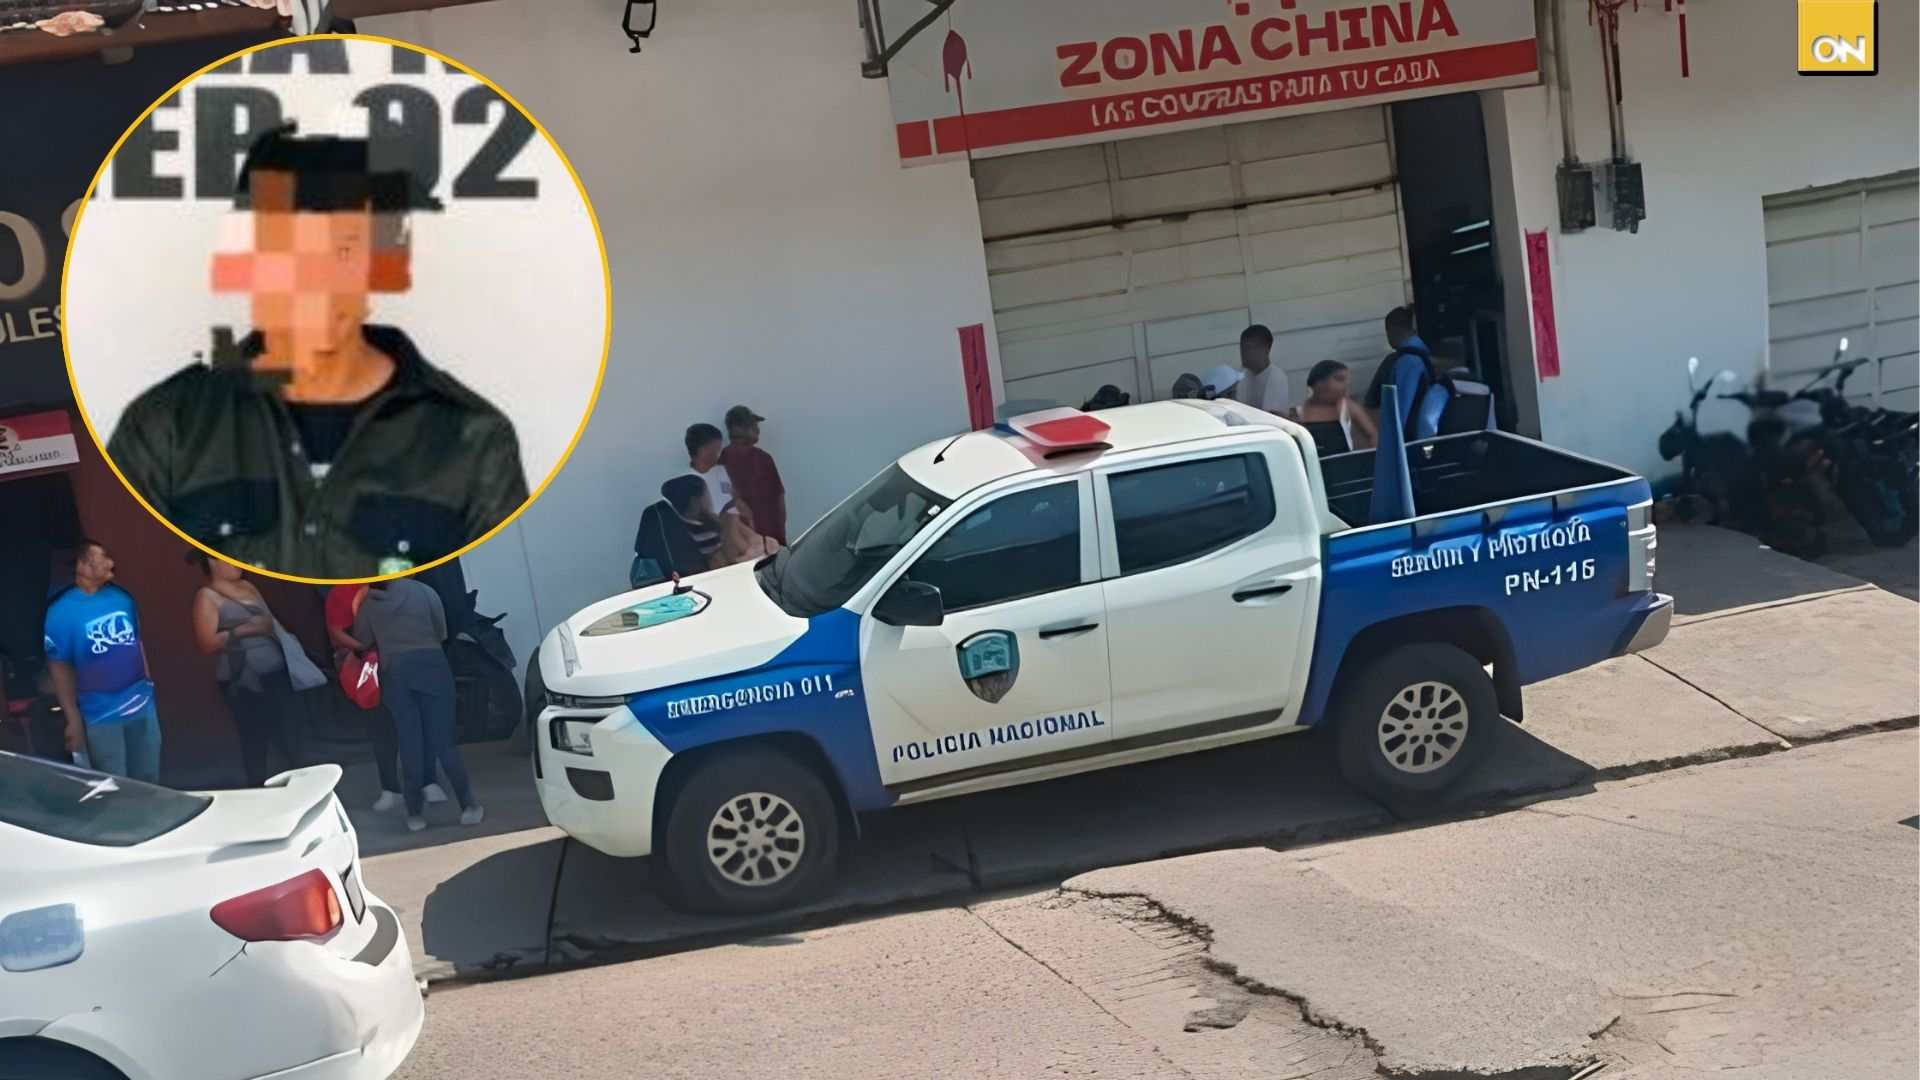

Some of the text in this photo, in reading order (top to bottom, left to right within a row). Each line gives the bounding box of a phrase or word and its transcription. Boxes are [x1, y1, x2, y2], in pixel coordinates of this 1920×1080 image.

[1056, 0, 1459, 87] ZONA CHINA
[1339, 69, 1368, 92] TU
[0, 304, 62, 344] LE
[1505, 558, 1595, 596] PN-116
